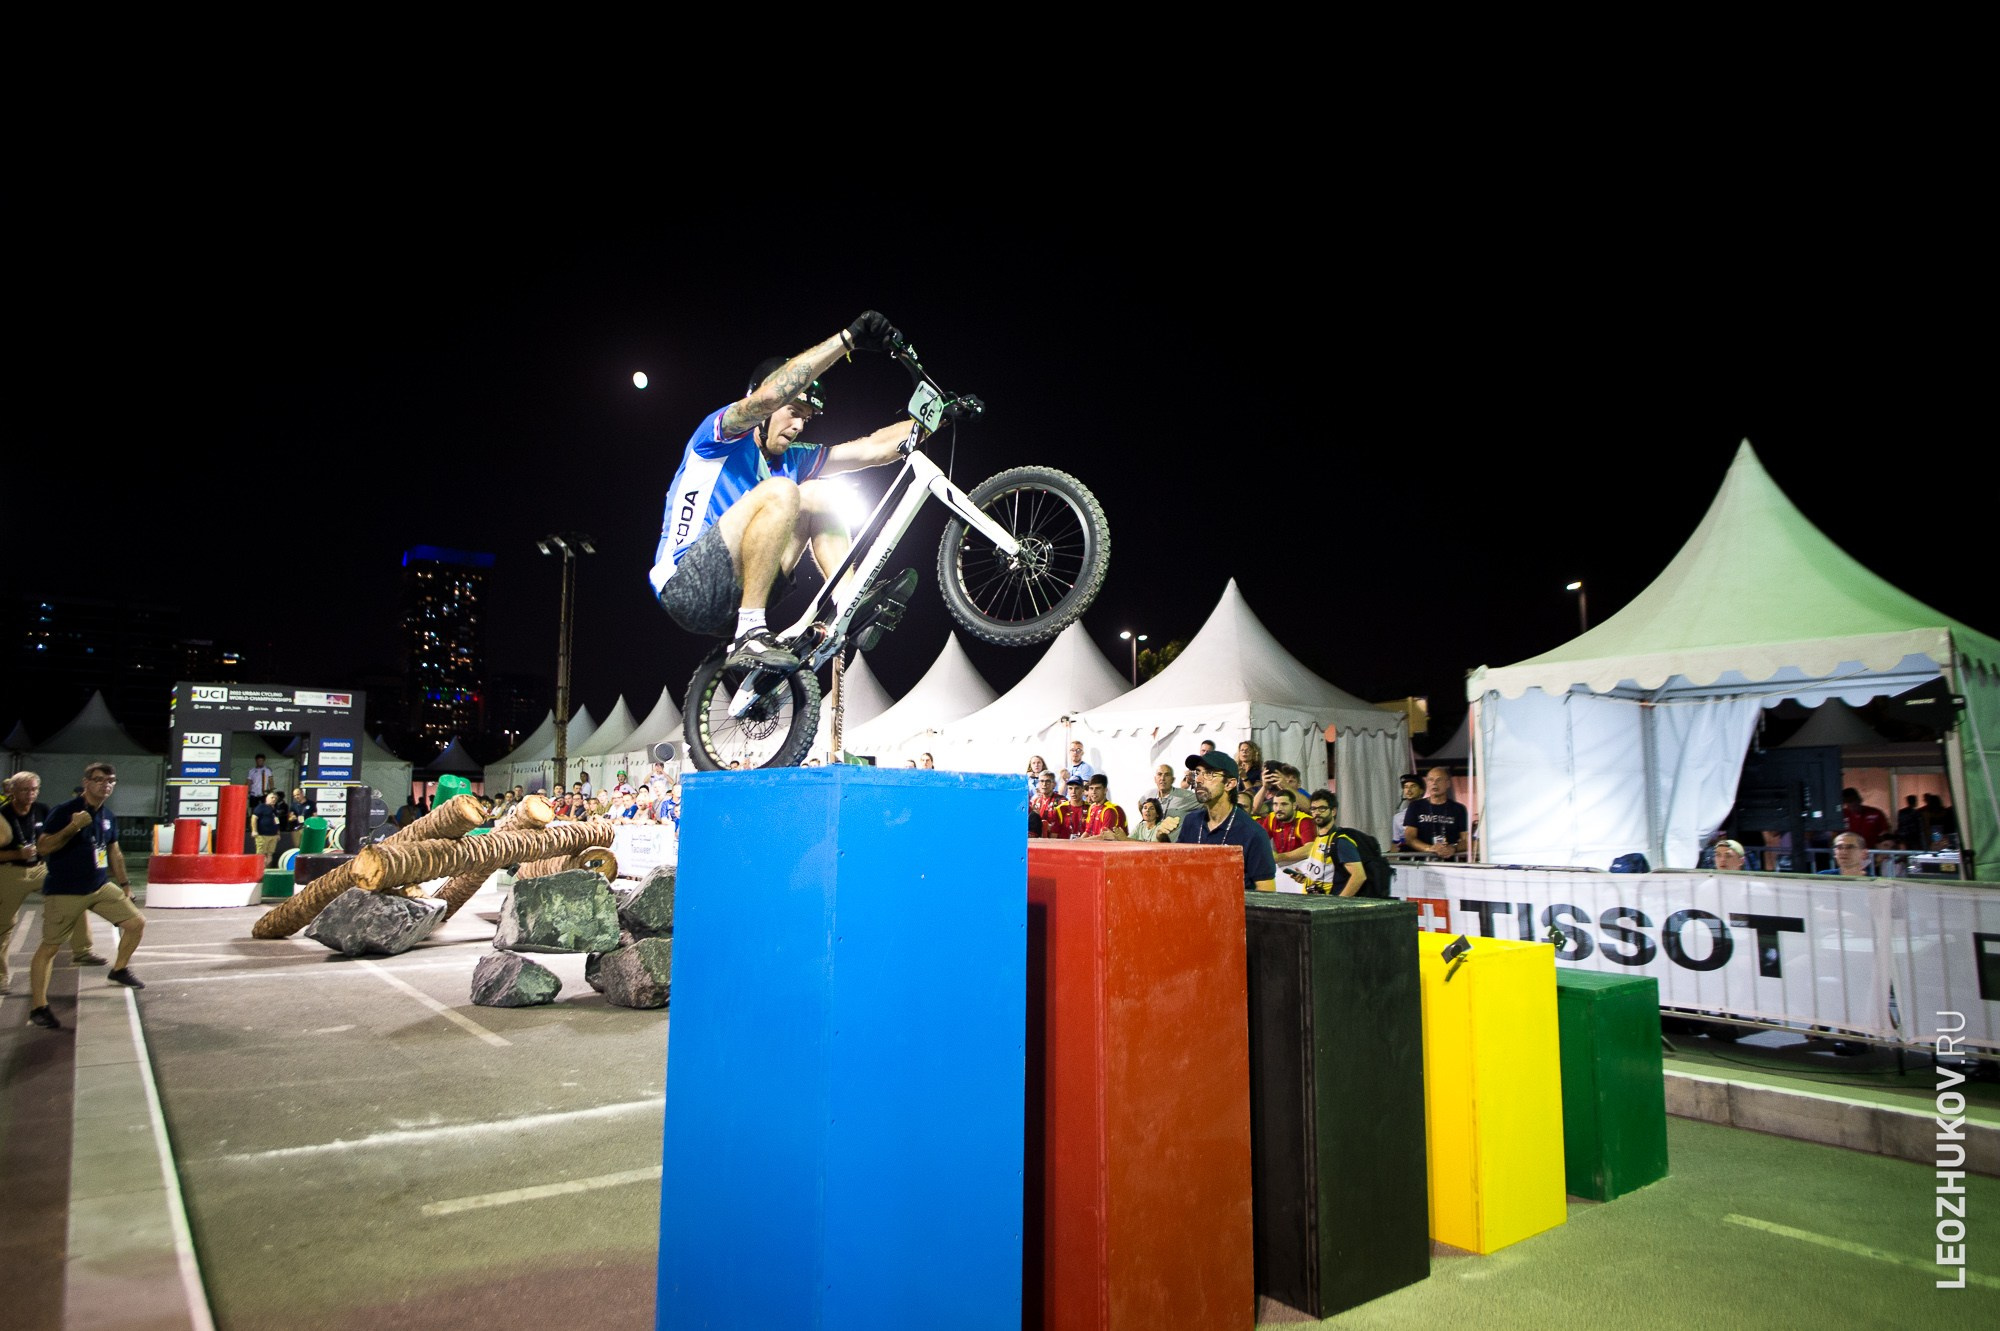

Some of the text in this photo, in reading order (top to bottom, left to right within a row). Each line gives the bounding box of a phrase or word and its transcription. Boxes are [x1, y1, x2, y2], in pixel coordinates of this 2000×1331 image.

[920, 402, 935, 422] 6E
[844, 548, 892, 617] MAESTRO
[199, 690, 224, 699] UCI
[254, 721, 292, 731] START
[190, 735, 215, 744] UCI
[1460, 898, 1805, 978] TISSOT
